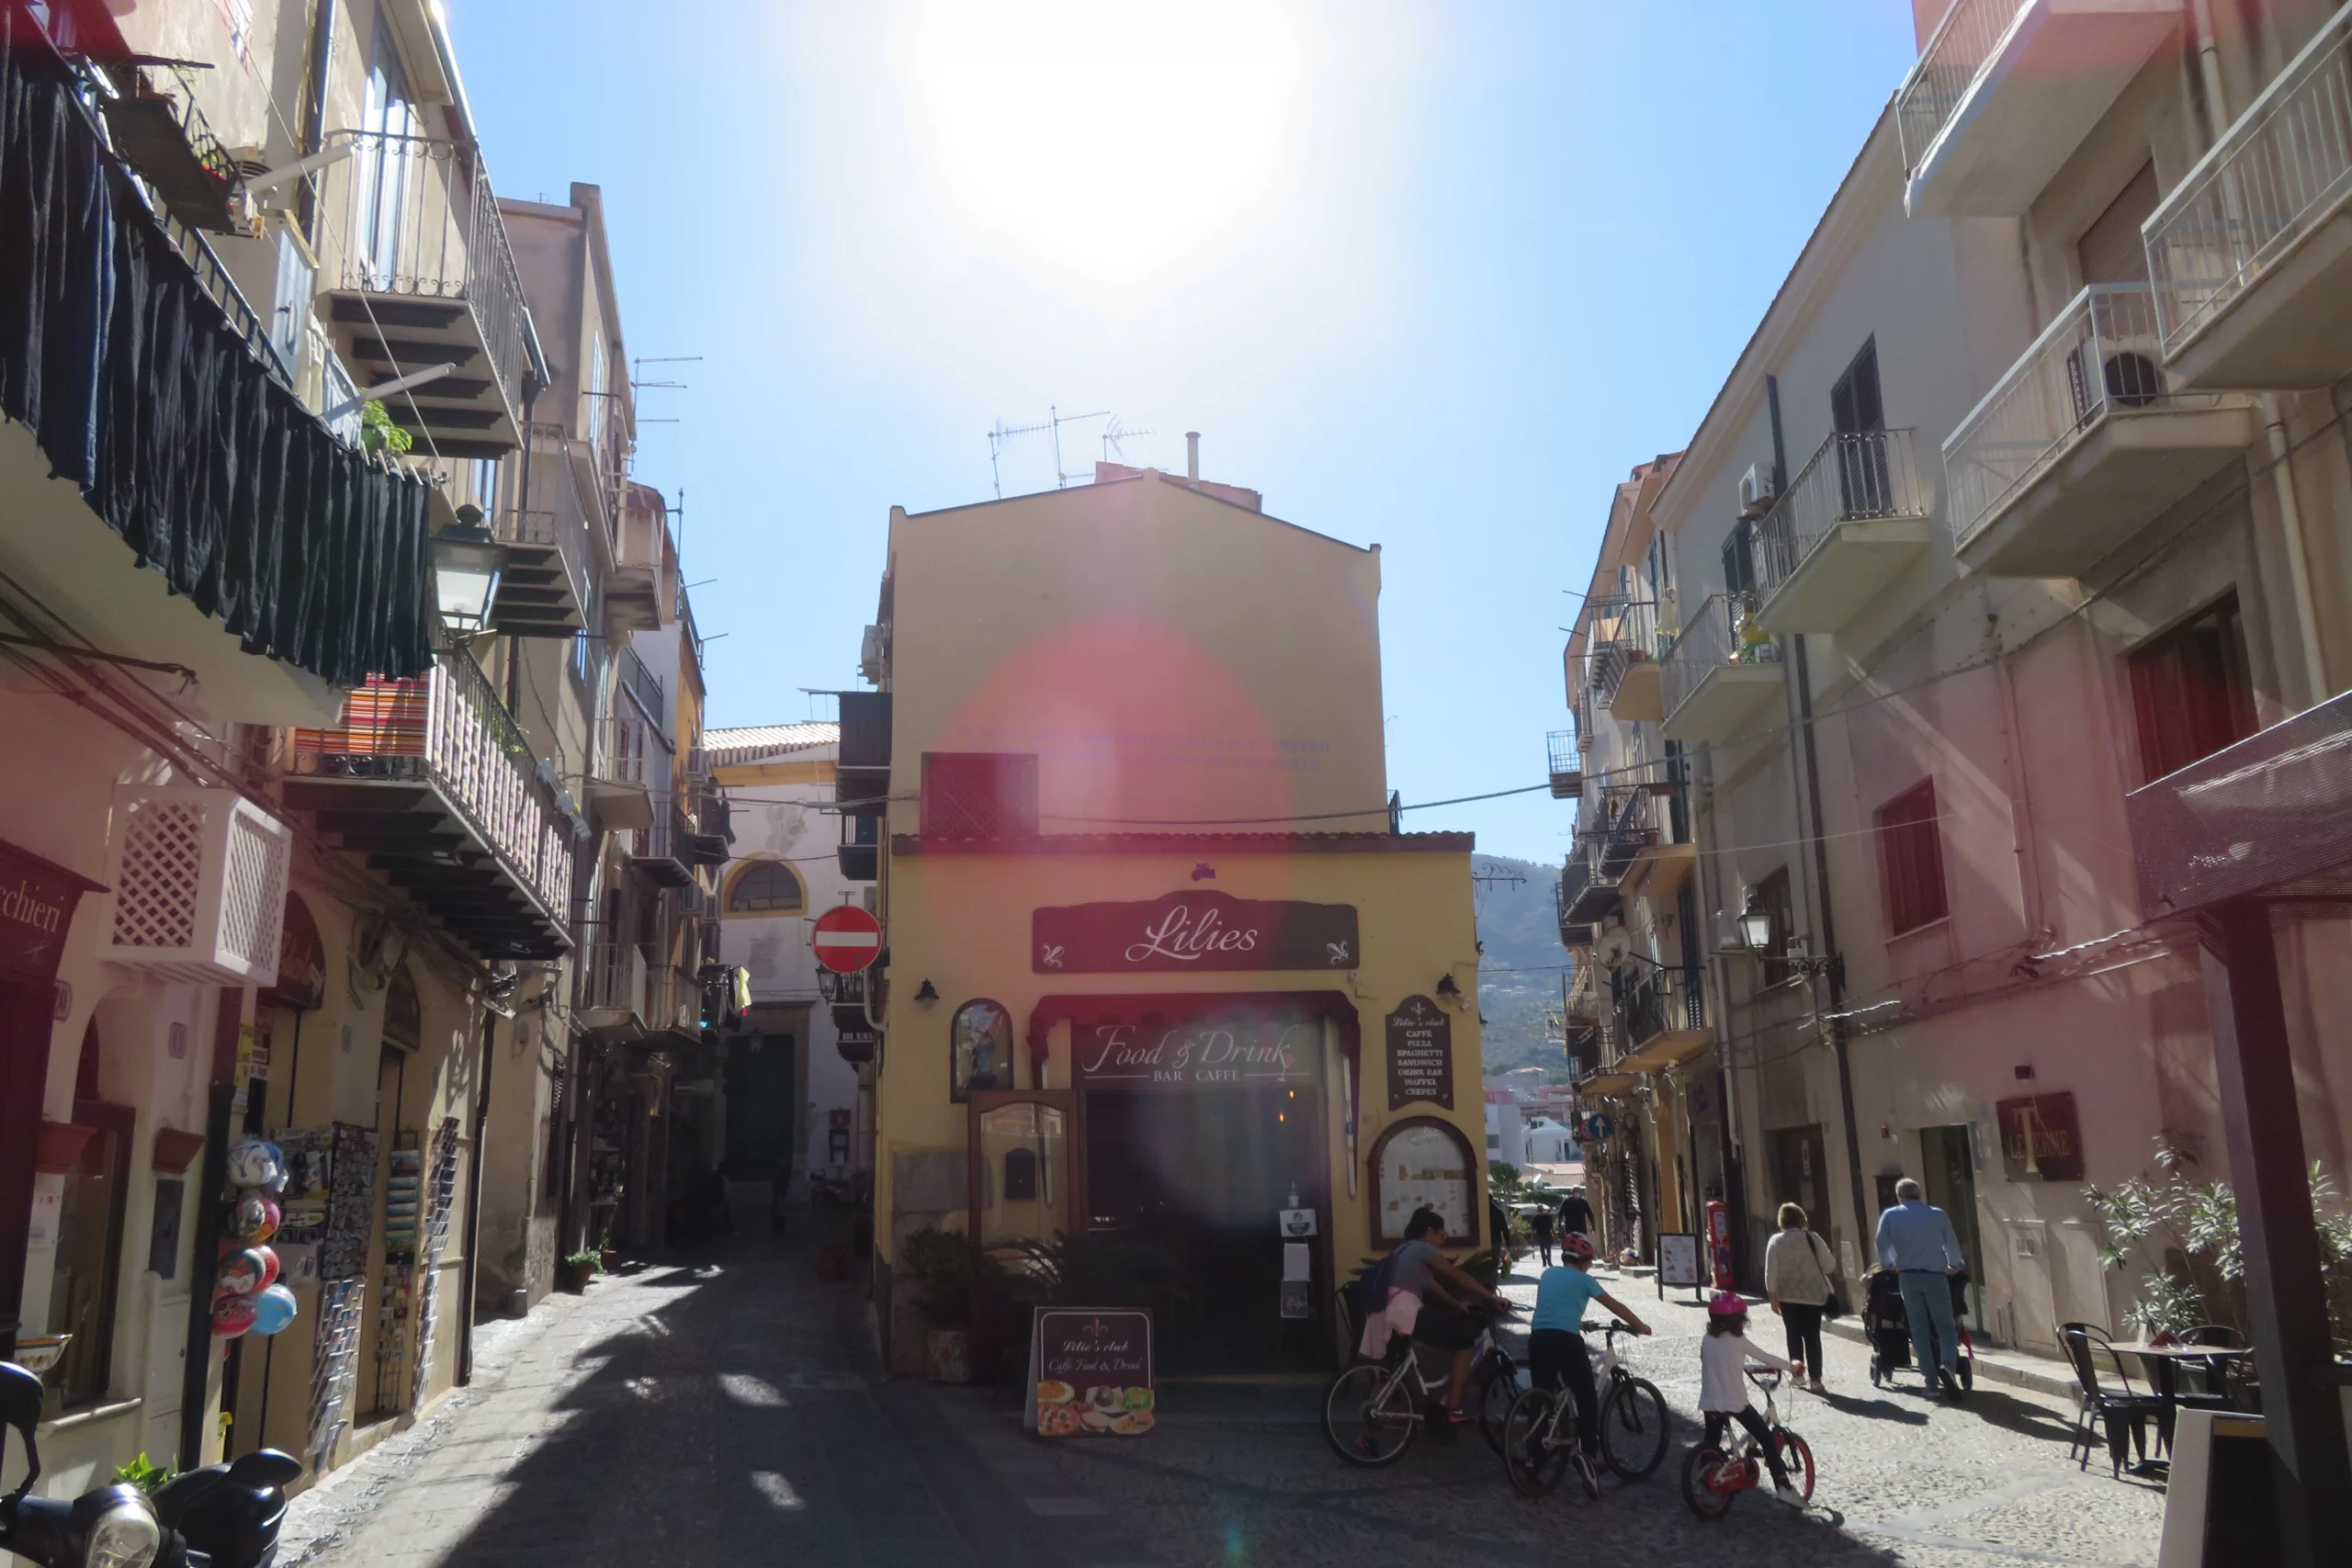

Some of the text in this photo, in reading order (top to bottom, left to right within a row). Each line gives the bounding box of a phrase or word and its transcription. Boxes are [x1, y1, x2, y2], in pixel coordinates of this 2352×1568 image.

[1125, 905, 1258, 962] Lilies
[1081, 1023, 1301, 1072] Food & Drink
[1154, 1071, 1183, 1082] BAR
[1397, 1068, 1443, 1077] DRINK BAR
[1075, 1358, 1099, 1371] Food
[1100, 1359, 1111, 1371] &
[1114, 1357, 1143, 1371] Drink
